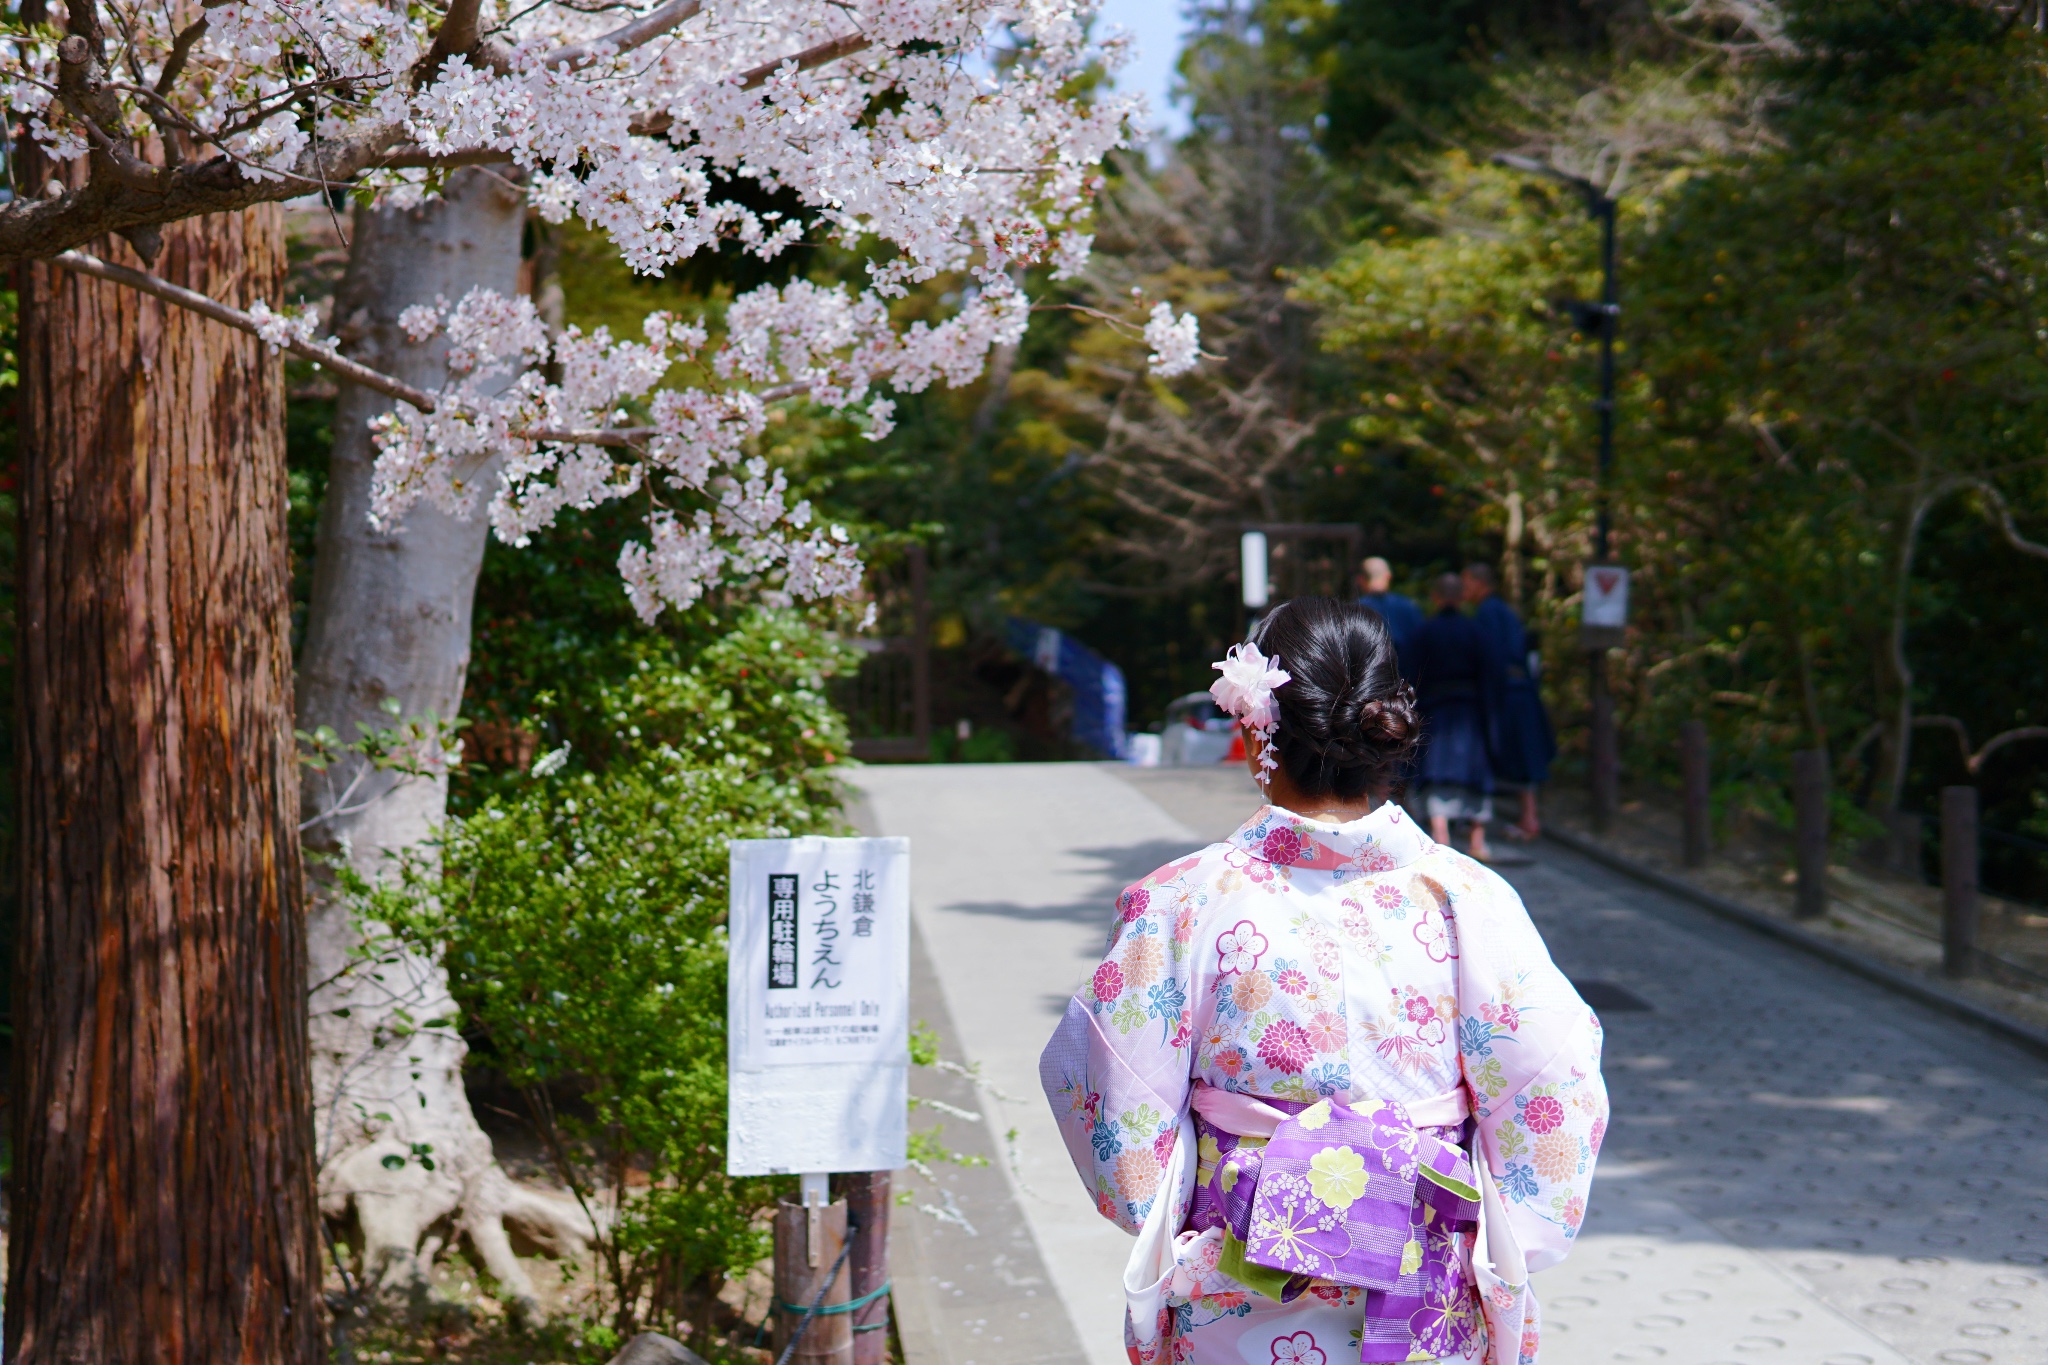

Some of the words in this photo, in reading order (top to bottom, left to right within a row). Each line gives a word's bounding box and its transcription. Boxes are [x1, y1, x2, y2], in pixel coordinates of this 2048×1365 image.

[771, 876, 796, 987] 専用駐輪場
[811, 870, 842, 990] ようちえん
[852, 869, 876, 938] 北鎌倉
[765, 1002, 811, 1018] Authorized
[815, 1001, 856, 1017] Personnel
[860, 1000, 879, 1018] Only
